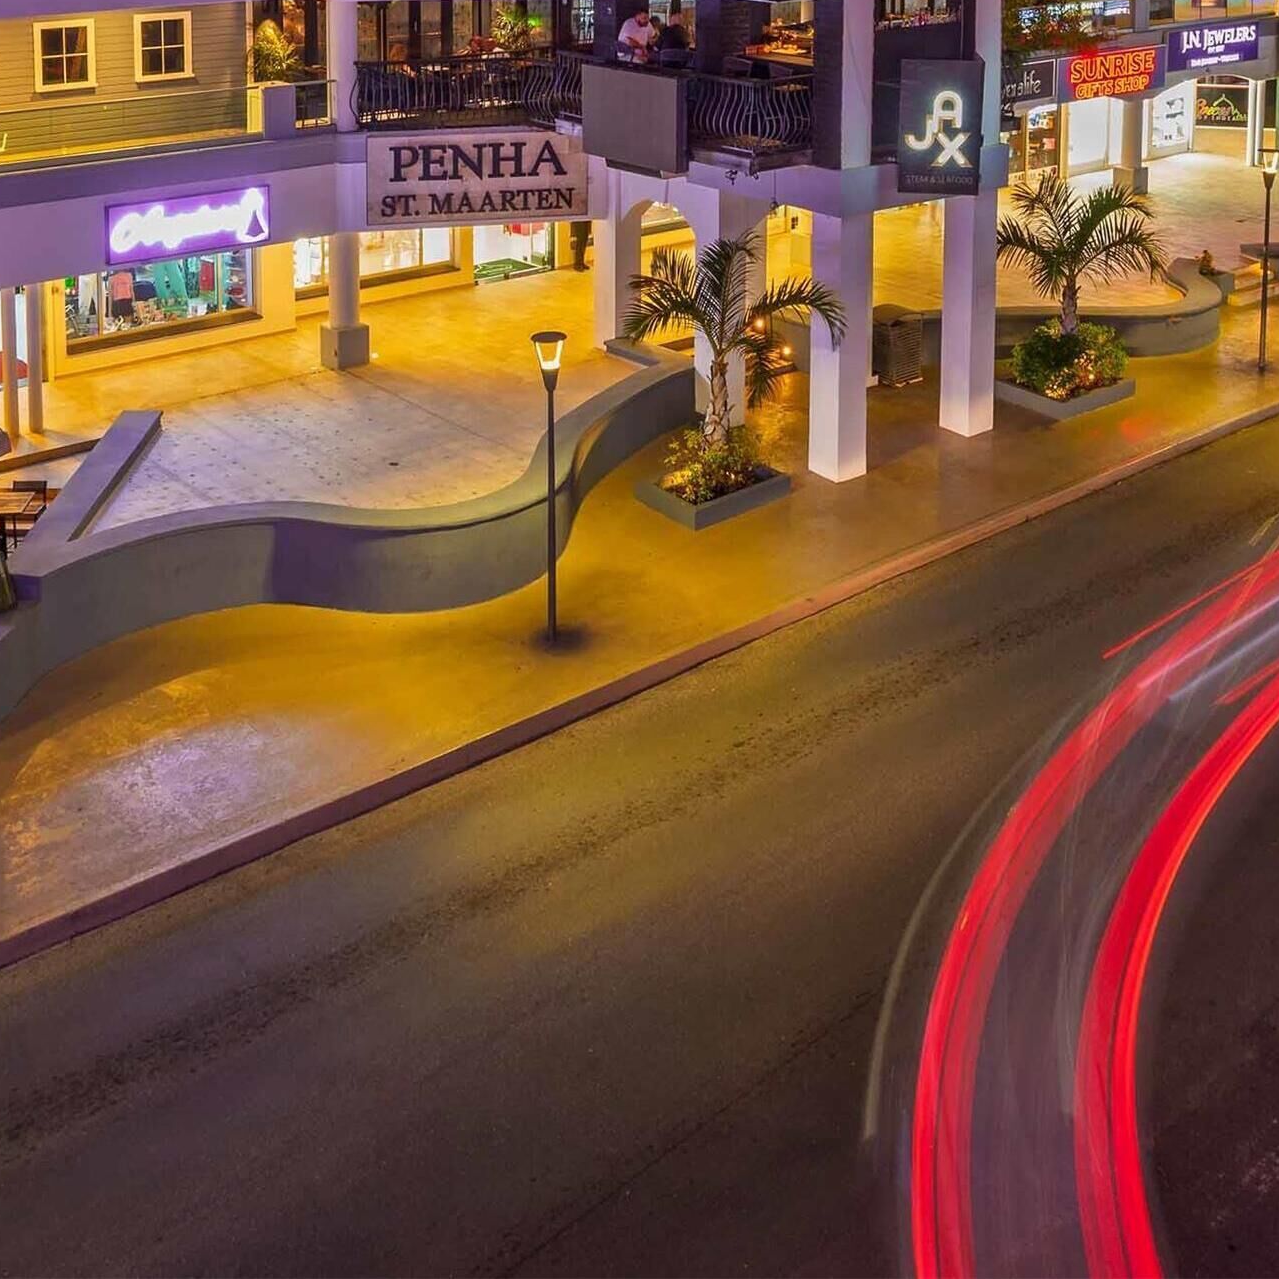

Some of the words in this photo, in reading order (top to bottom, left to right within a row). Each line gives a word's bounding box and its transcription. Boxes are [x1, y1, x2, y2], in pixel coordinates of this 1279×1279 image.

[1202, 25, 1256, 51] JEWELERS
[1070, 49, 1155, 84] SUNRISE
[1076, 80, 1113, 99] GIFTS
[1114, 74, 1149, 94] SHOP
[389, 140, 568, 182] PENHA
[381, 194, 420, 217] ST.
[428, 188, 575, 216] MAARTEN
